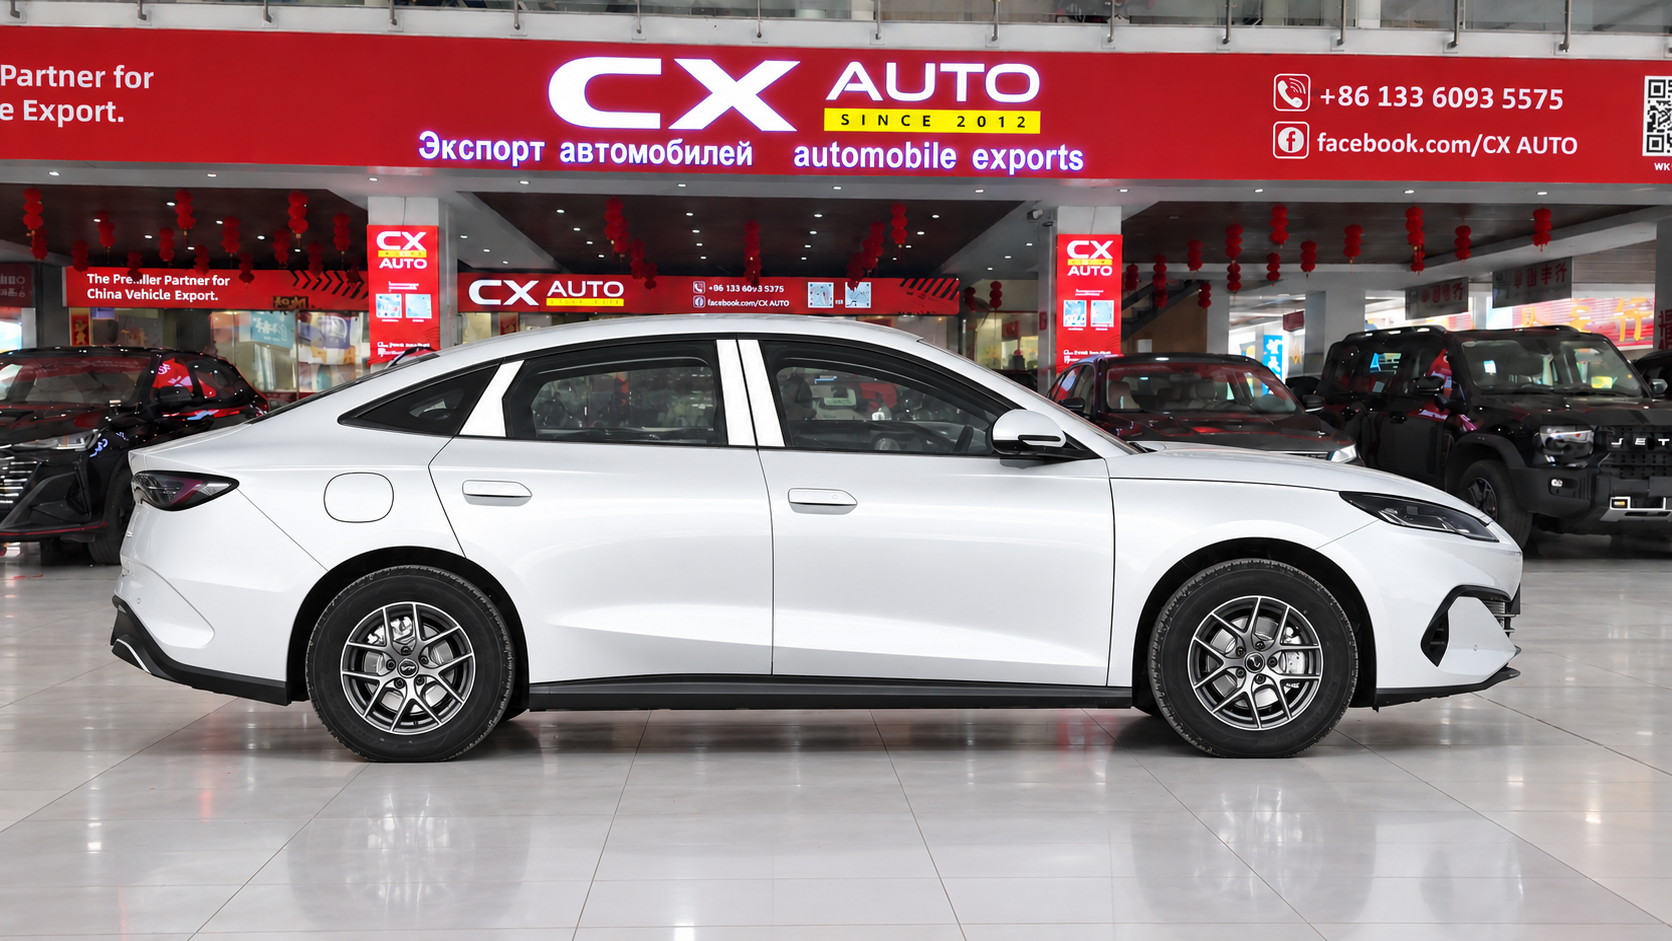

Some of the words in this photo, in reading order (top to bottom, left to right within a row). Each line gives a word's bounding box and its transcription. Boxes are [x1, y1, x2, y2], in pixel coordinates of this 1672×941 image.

[0, 64, 106, 88] Partner
[113, 64, 154, 89] for
[549, 57, 800, 132] CX
[826, 61, 1040, 103] AUTO
[1320, 85, 1370, 107] +86
[1378, 86, 1424, 107] 133
[1432, 87, 1494, 108] 6093
[1502, 88, 1564, 110] 5575
[23, 99, 124, 128] Export.
[841, 114, 931, 127] SINCE
[957, 115, 1025, 128] 2012
[419, 131, 546, 166] Экспорт
[560, 138, 753, 166] автомобилей
[1317, 132, 1510, 158] facebook.com/CX
[1515, 136, 1578, 155] AUTO
[794, 142, 957, 169] automobile
[972, 144, 1084, 175] exports
[1654, 162, 1672, 171] WK
[376, 231, 427, 251] CX
[1066, 240, 1114, 259] CX
[378, 258, 428, 270] AUTO
[1067, 264, 1113, 276] AUTO
[87, 273, 110, 284] The
[164, 275, 210, 286] Partner
[212, 275, 231, 286] for
[726, 284, 740, 292] 133
[87, 288, 122, 299] China
[125, 289, 171, 300] Vehicle
[174, 290, 219, 303] Export.
[468, 279, 539, 306] CX
[547, 280, 625, 298] AUTO
[769, 300, 790, 308] AUTO
